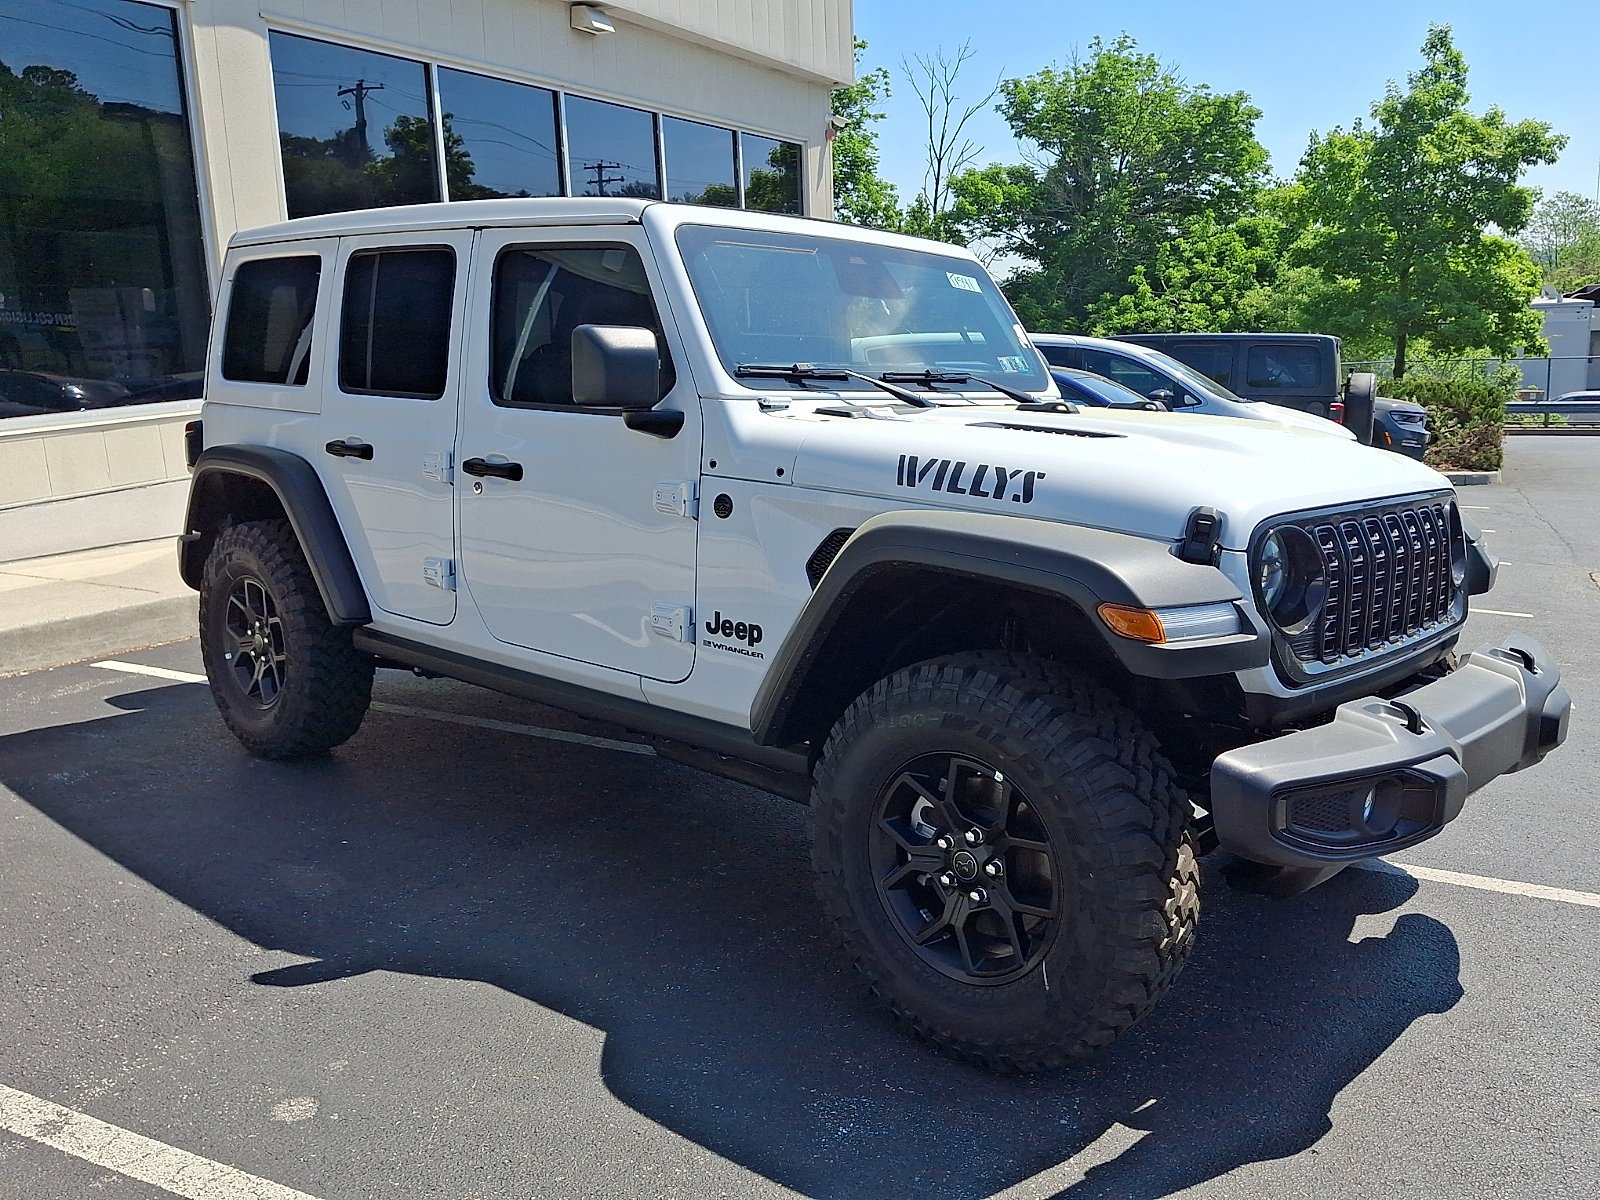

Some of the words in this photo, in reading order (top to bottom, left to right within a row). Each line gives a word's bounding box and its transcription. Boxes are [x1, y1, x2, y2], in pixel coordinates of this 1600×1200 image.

[897, 454, 1046, 504] WILLYS
[705, 610, 763, 648] Jeep
[711, 641, 765, 660] WRANGLER
